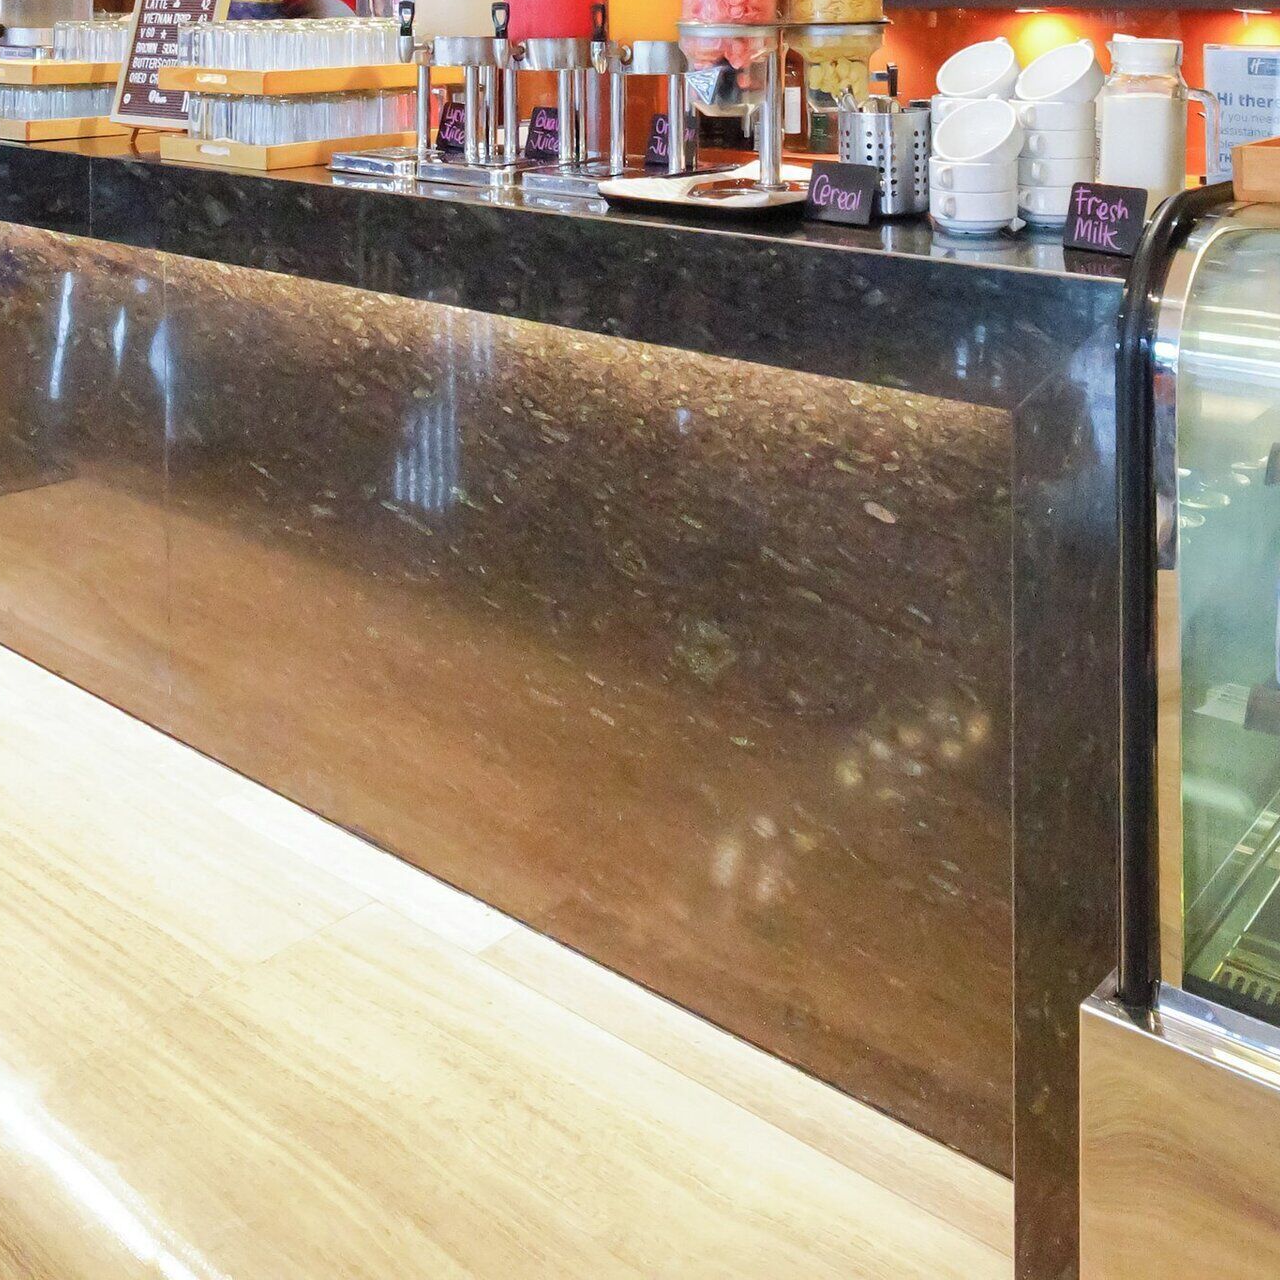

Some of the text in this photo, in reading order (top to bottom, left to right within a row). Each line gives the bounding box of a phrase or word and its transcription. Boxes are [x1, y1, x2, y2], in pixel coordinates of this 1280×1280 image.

[143, 12, 174, 25] VIETNAM
[129, 72, 147, 85] OREO
[1217, 91, 1233, 106] Hi
[1228, 111, 1249, 123] you
[812, 174, 862, 212] Cereal
[1074, 186, 1129, 223] Fresh
[1073, 217, 1122, 250] Milk
